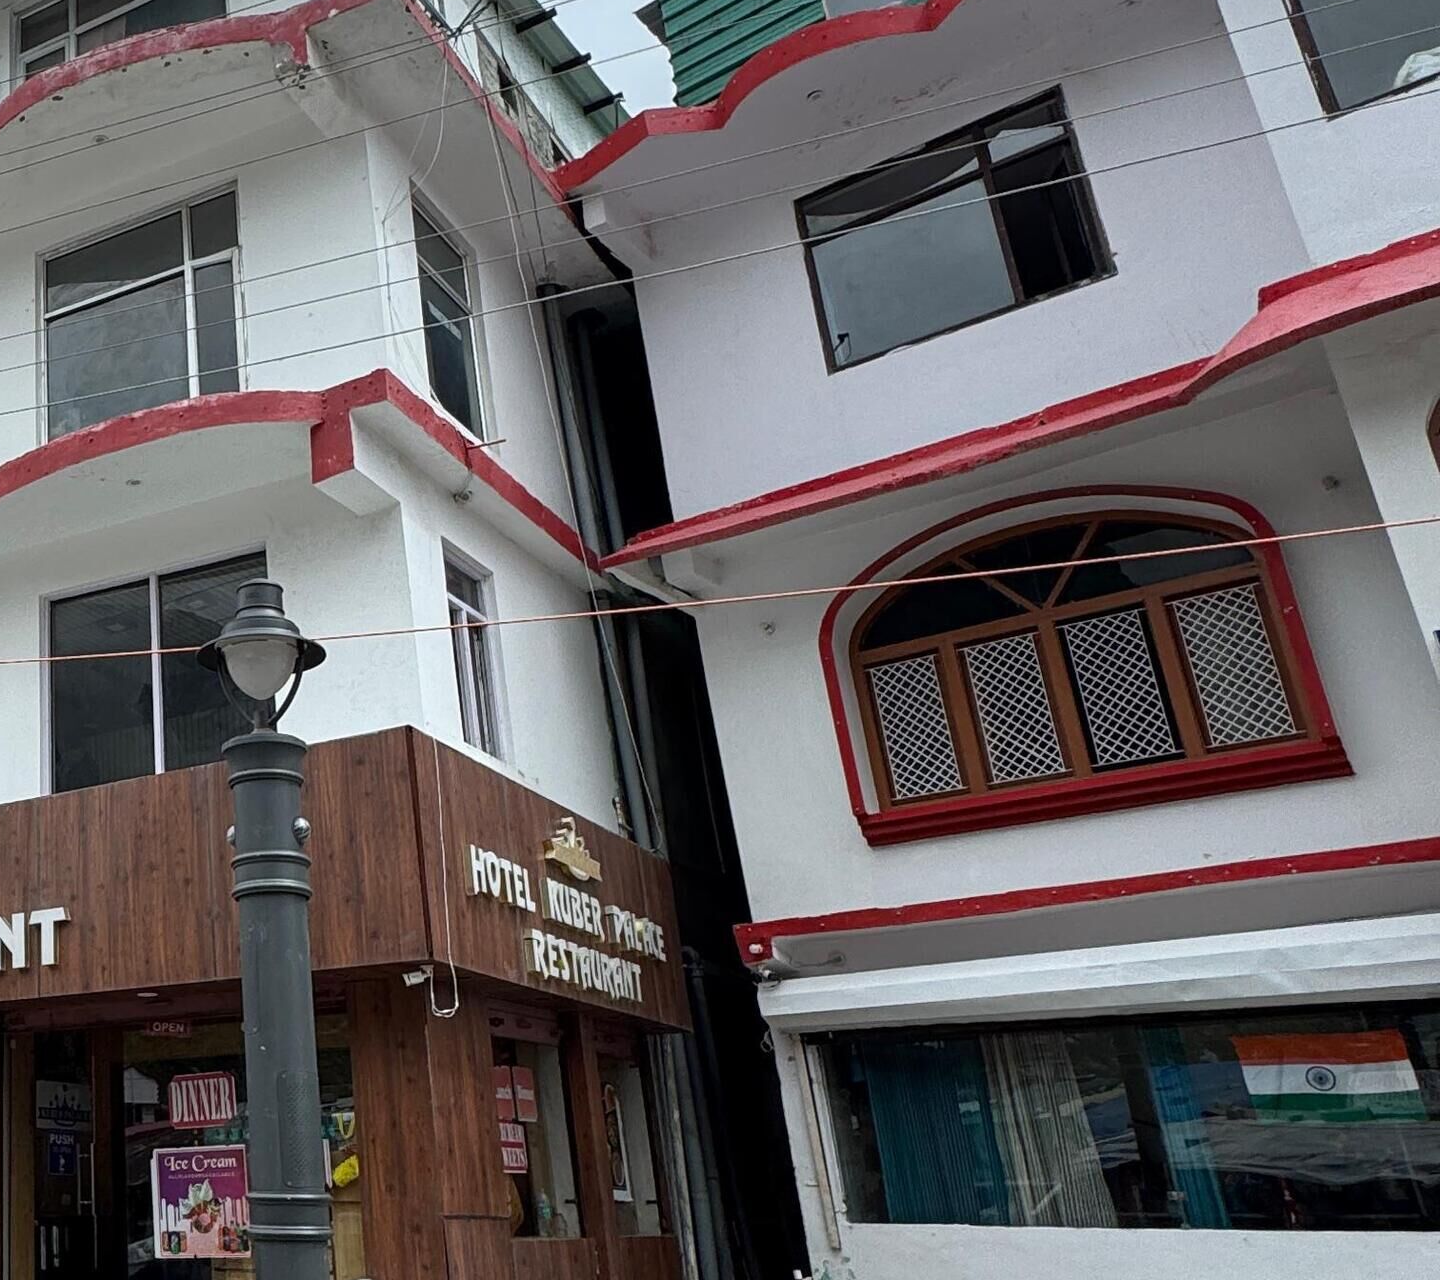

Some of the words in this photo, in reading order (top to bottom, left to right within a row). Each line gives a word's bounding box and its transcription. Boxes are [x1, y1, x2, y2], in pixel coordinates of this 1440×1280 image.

[465, 844, 536, 913] HOTEL
[542, 877, 606, 943] KUBER
[605, 905, 667, 962] PALACE
[524, 928, 643, 1002] RESTAURANT
[152, 1021, 185, 1033] OPEN
[170, 1076, 233, 1124] DINNER
[49, 1133, 75, 1145] PUSH
[164, 1155, 189, 1172] Ice
[191, 1154, 237, 1173] Cream
